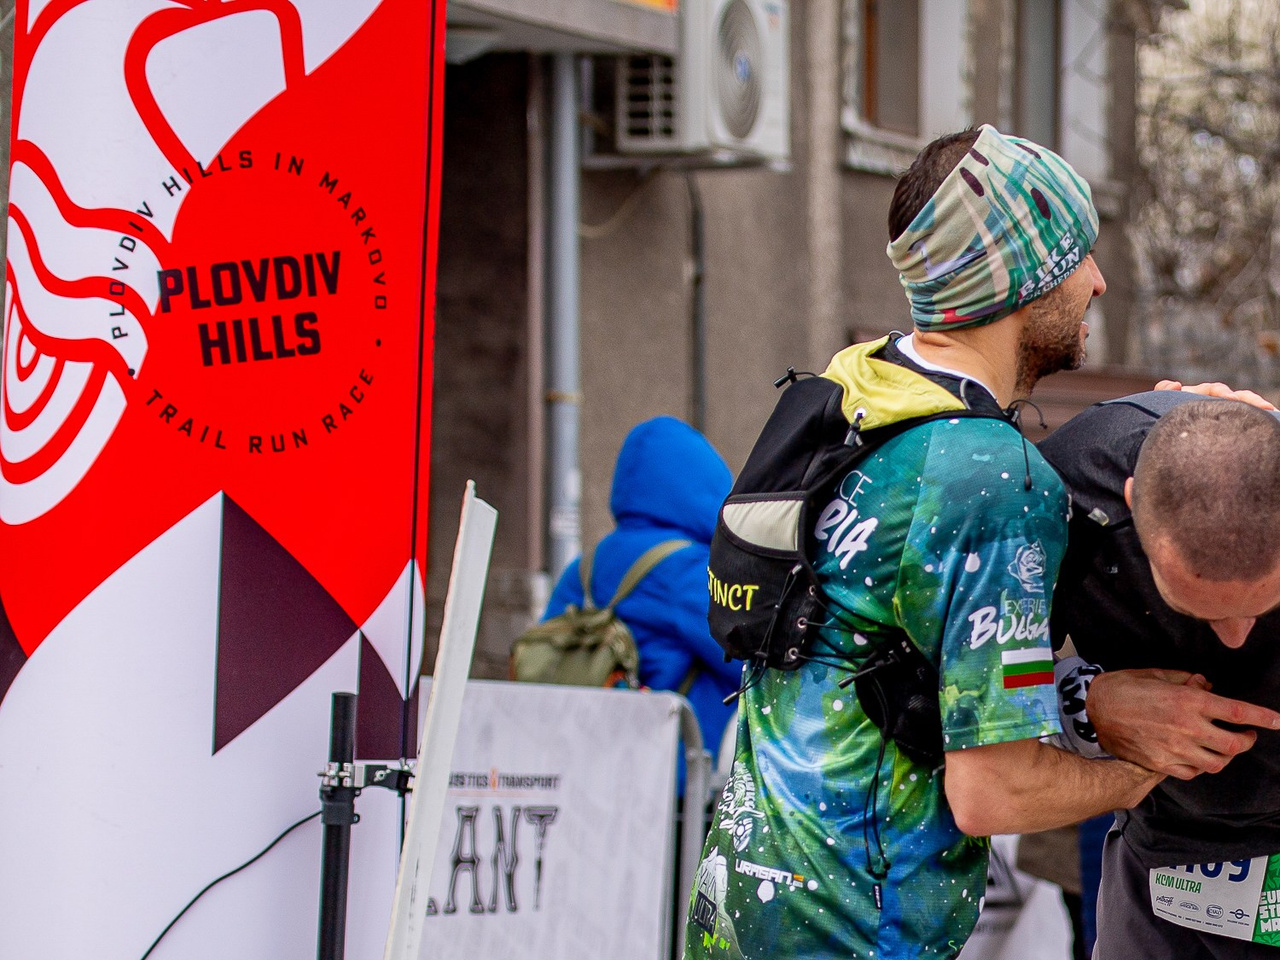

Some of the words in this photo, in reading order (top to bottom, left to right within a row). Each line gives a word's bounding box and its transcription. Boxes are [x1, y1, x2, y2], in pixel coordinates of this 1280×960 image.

[109, 201, 153, 339] PLOVDIV
[162, 150, 253, 196] HILLS
[274, 152, 304, 176] IN
[319, 172, 387, 309] MARKOVO
[157, 251, 341, 313] PLOVDIV
[198, 312, 322, 367] HILLS
[146, 389, 226, 449] TRAIL
[249, 429, 308, 454] RUN
[322, 369, 374, 433] RACE
[428, 804, 559, 915] ANT
[1175, 877, 1202, 893] ULTRA
